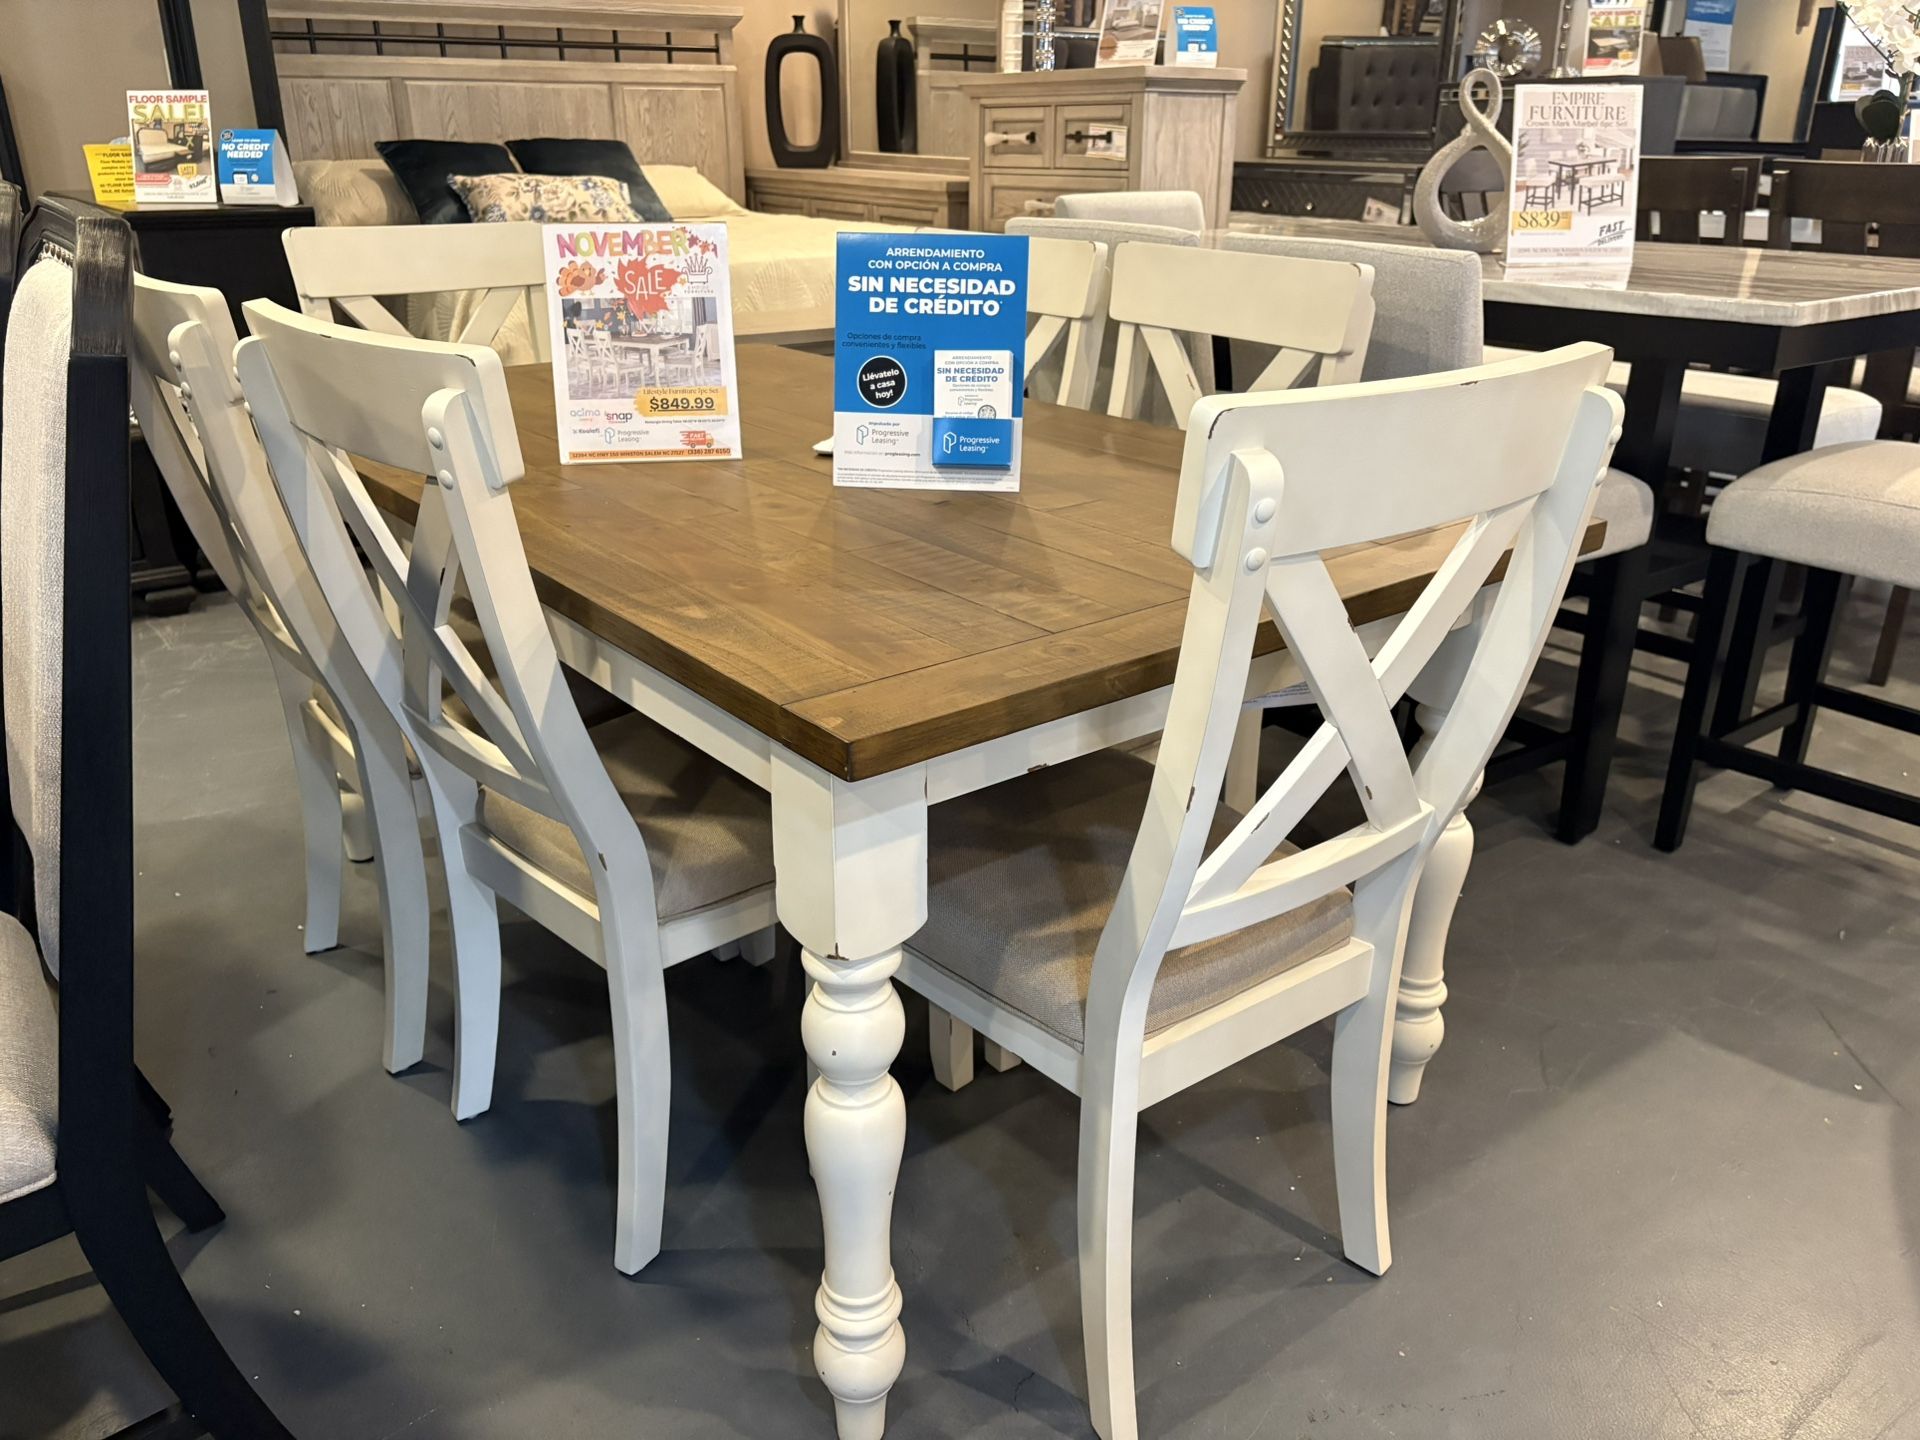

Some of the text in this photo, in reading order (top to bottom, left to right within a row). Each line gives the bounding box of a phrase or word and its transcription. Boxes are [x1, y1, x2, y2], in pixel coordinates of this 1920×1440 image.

[129, 95, 207, 103] FLOOR SAMPLE
[1552, 91, 1605, 105] EMPIRE
[133, 104, 204, 124] SALE!
[1529, 105, 1626, 121] FURNITURE
[221, 143, 270, 151] NO CREDIT
[227, 151, 264, 159] NEEDED
[1599, 220, 1625, 236] FAST
[556, 230, 690, 258] NOVEMBER
[886, 247, 985, 259] ARRENDAMIENTO
[868, 259, 1003, 272] CON OPCIÓN A COMPRA
[624, 270, 666, 300] SALE
[848, 275, 1016, 296] SIN NECESIDAD
[869, 297, 898, 313] DE
[847, 332, 922, 342] Opciones de compra
[842, 341, 890, 349] convenientes
[862, 368, 900, 382] Llévatelo
[959, 374, 998, 382] CRÉDITO
[876, 380, 896, 389] casa
[643, 388, 668, 396] Lifestyle
[875, 389, 894, 399] hoy!
[649, 396, 714, 412] $849.99
[570, 408, 600, 417] acima
[606, 412, 633, 423] snap
[871, 429, 909, 437] Progressive
[872, 437, 897, 445] Leasing
[959, 436, 1000, 444] Progressive
[959, 445, 986, 453] Leasing
